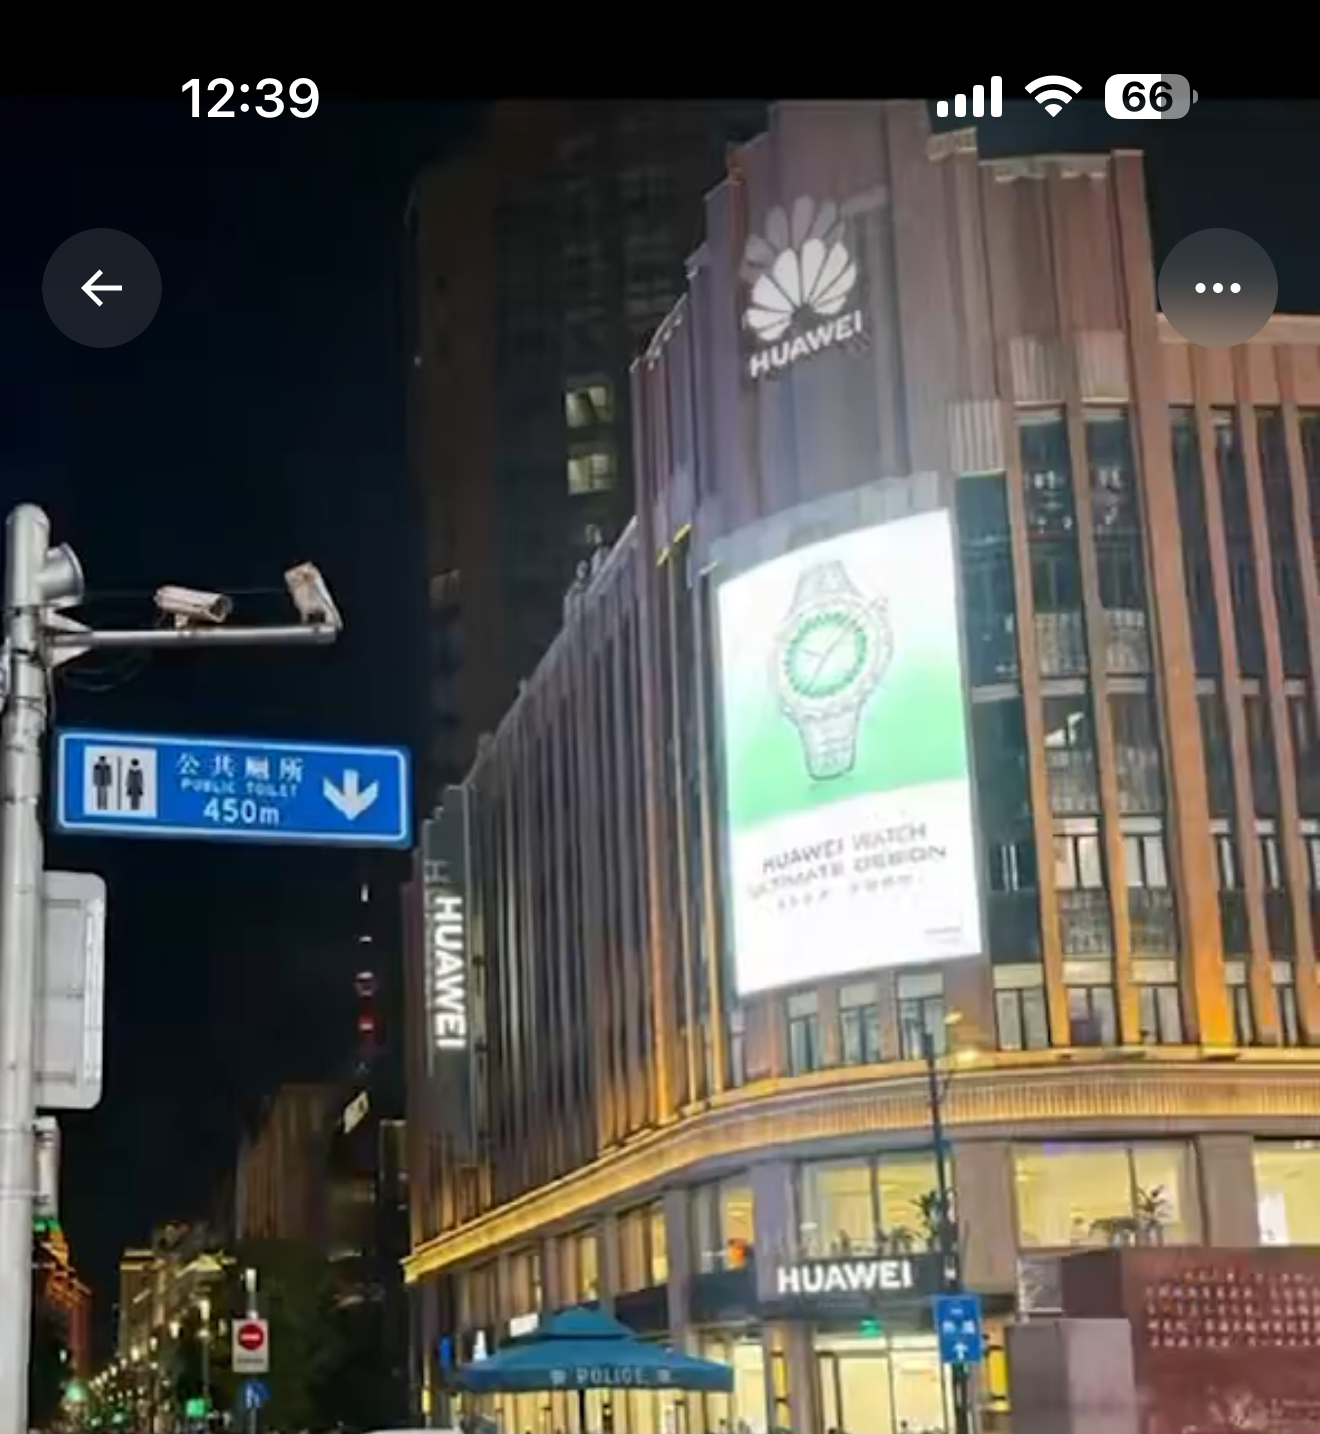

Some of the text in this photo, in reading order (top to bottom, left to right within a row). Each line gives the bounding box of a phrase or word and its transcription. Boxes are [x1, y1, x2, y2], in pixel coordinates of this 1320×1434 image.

[750, 309, 863, 379] HUAWEI
[203, 797, 280, 825] 450m
[762, 837, 844, 875] HUAWEI
[434, 896, 468, 1050] HUAWEI
[777, 1256, 914, 1294] HUAWEI
[575, 1367, 648, 1385] POLICE
